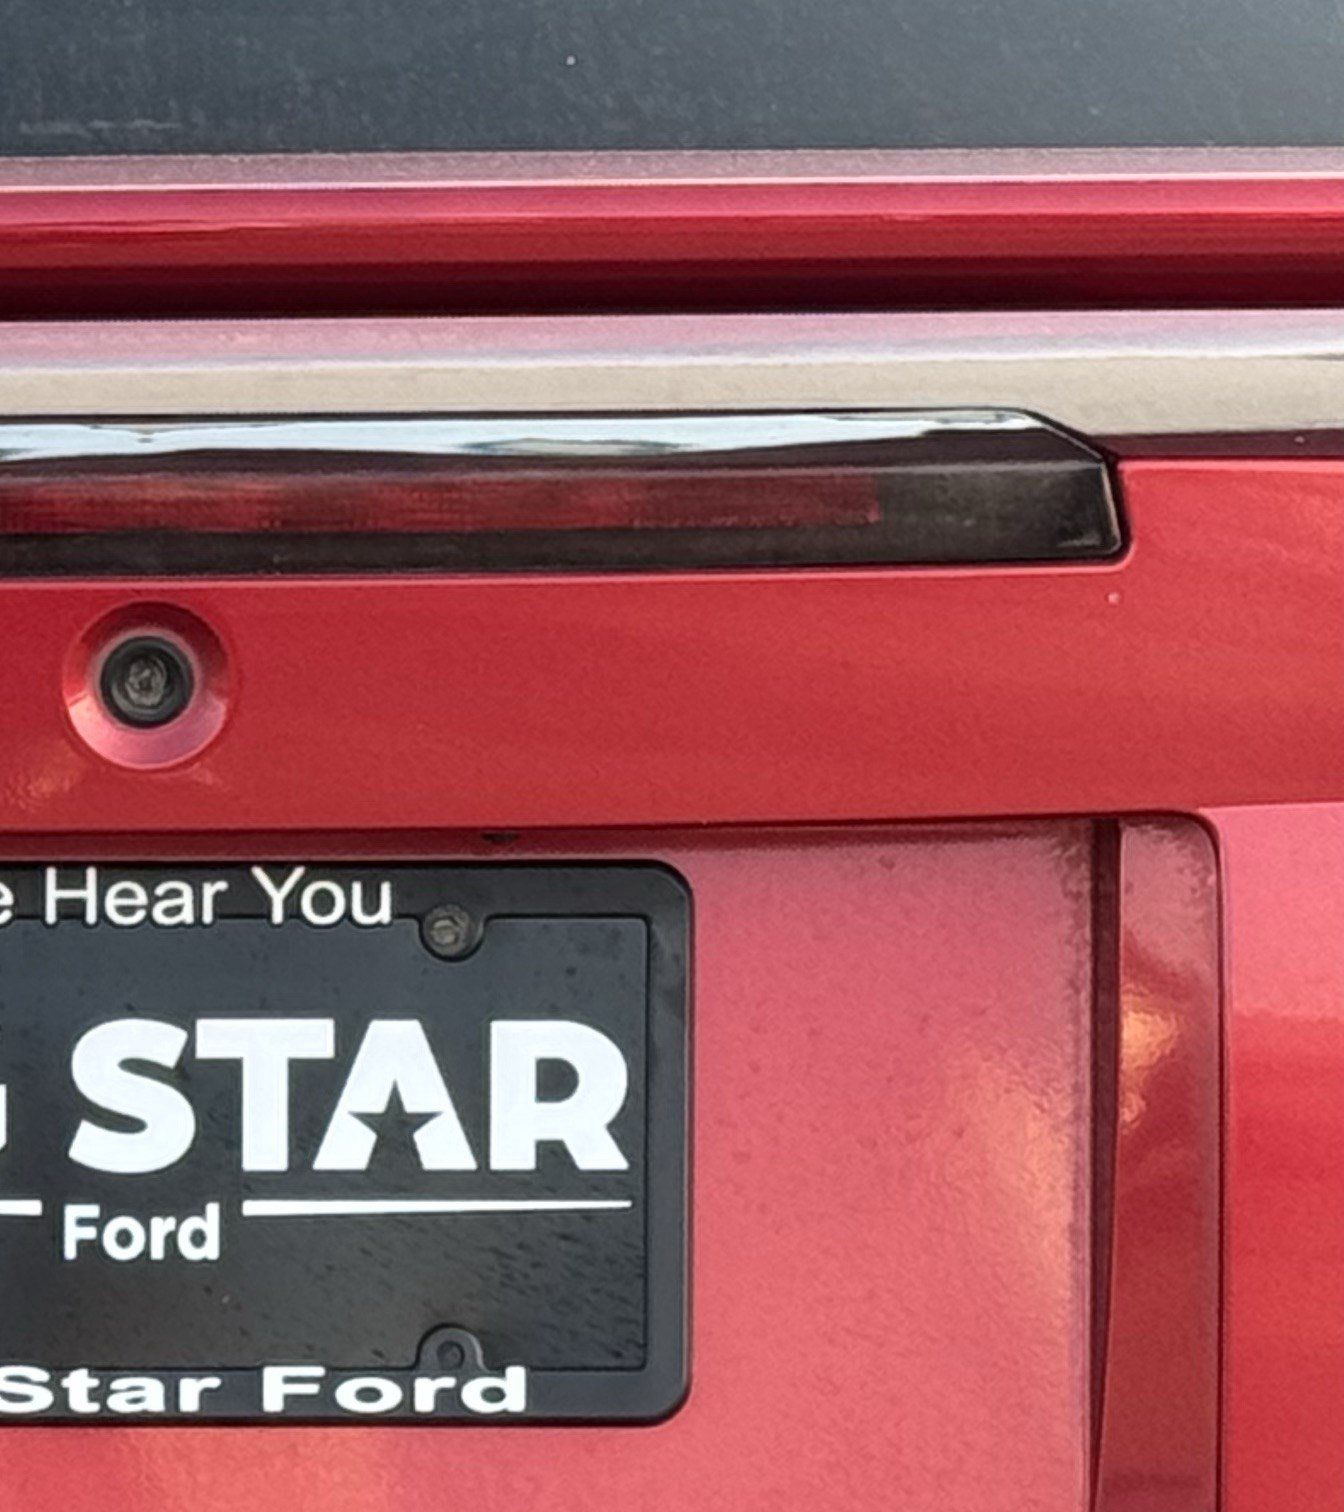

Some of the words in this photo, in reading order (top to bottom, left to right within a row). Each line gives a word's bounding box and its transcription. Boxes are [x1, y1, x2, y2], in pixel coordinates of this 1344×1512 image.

[45, 867, 229, 926] Hear
[251, 866, 392, 925] You
[68, 1017, 630, 1174] STAR
[63, 1201, 220, 1261] Ford
[262, 1365, 527, 1413] Ford
